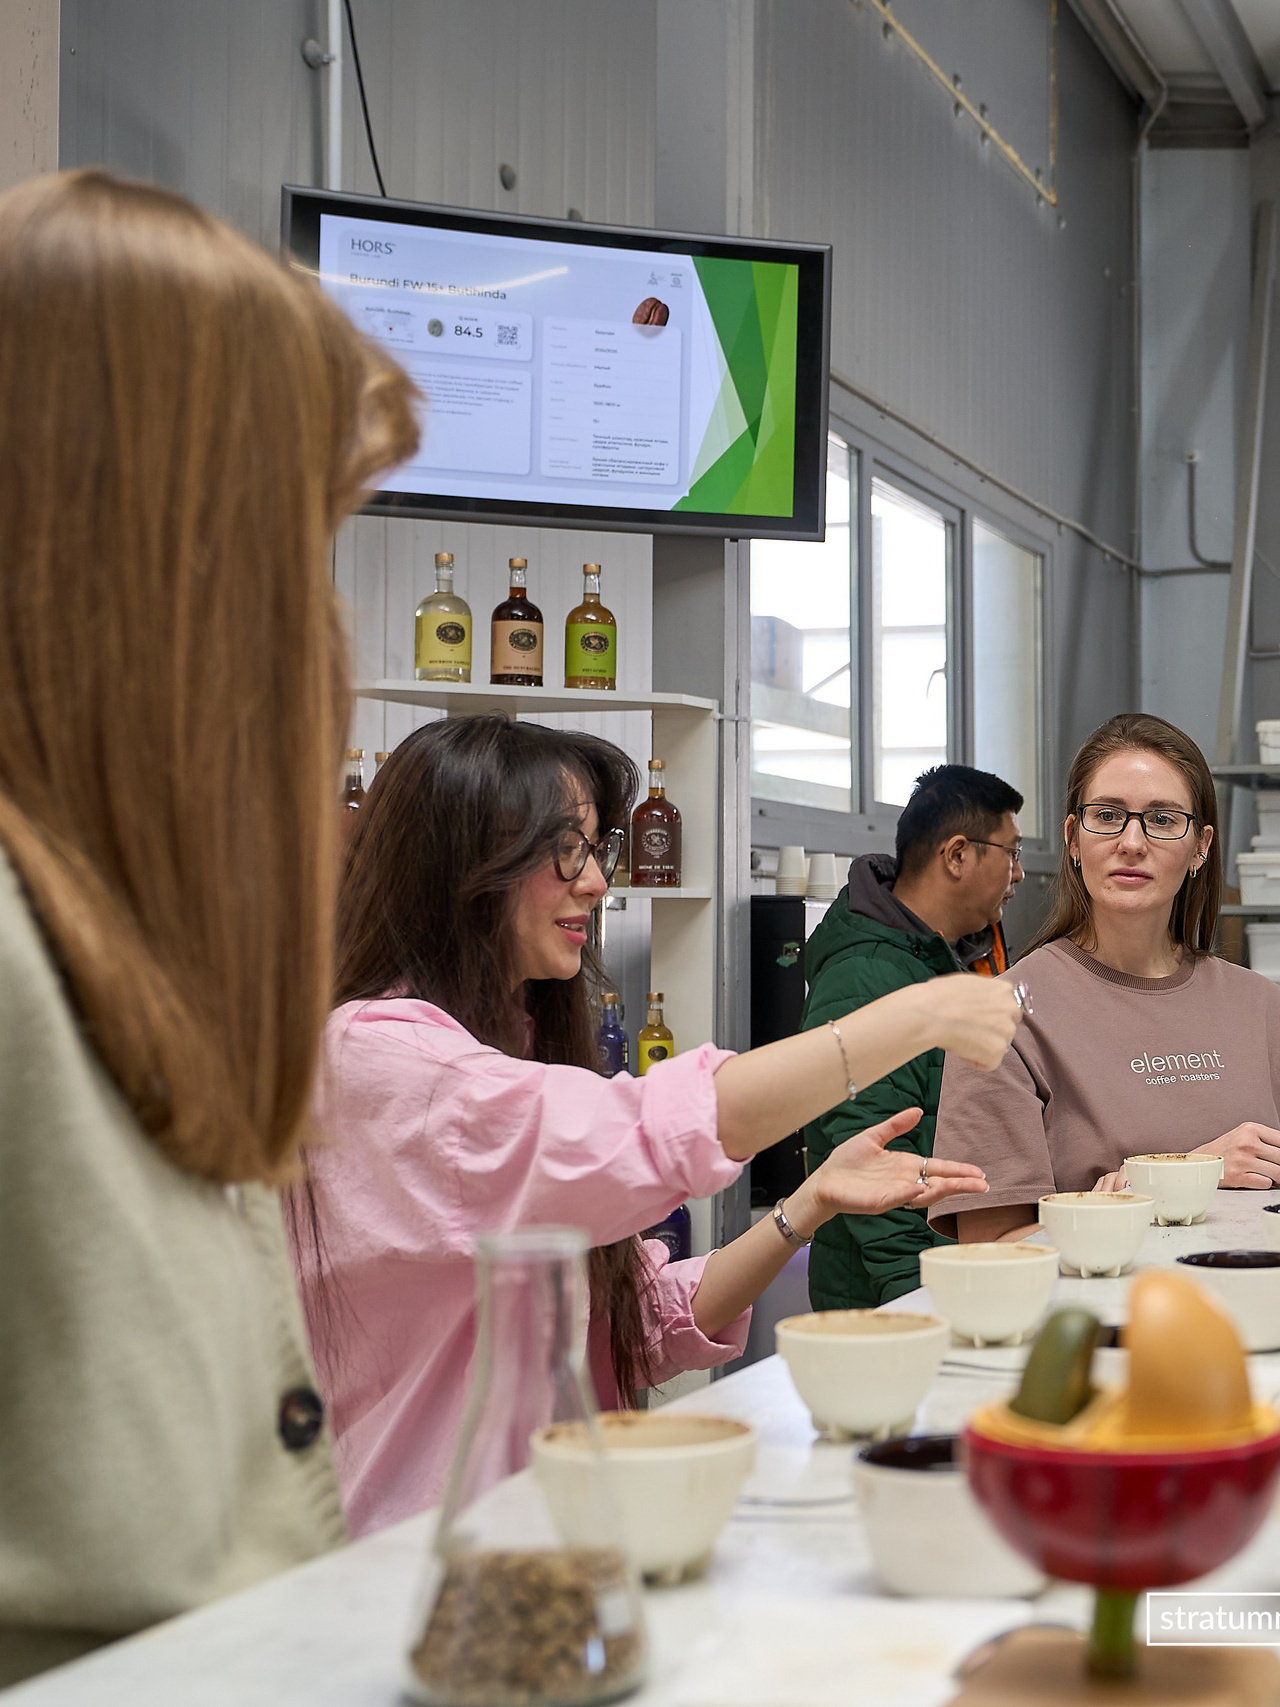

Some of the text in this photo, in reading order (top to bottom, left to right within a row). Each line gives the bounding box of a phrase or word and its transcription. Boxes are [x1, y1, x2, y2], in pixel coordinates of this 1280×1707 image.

[351, 238, 394, 255] HORS
[349, 272, 400, 288] Burundi
[403, 278, 423, 291] FW
[448, 283, 507, 300] Butihinda
[453, 325, 483, 339] 84.5
[1130, 1049, 1225, 1074] element
[1145, 1072, 1221, 1086] coffee roasters
